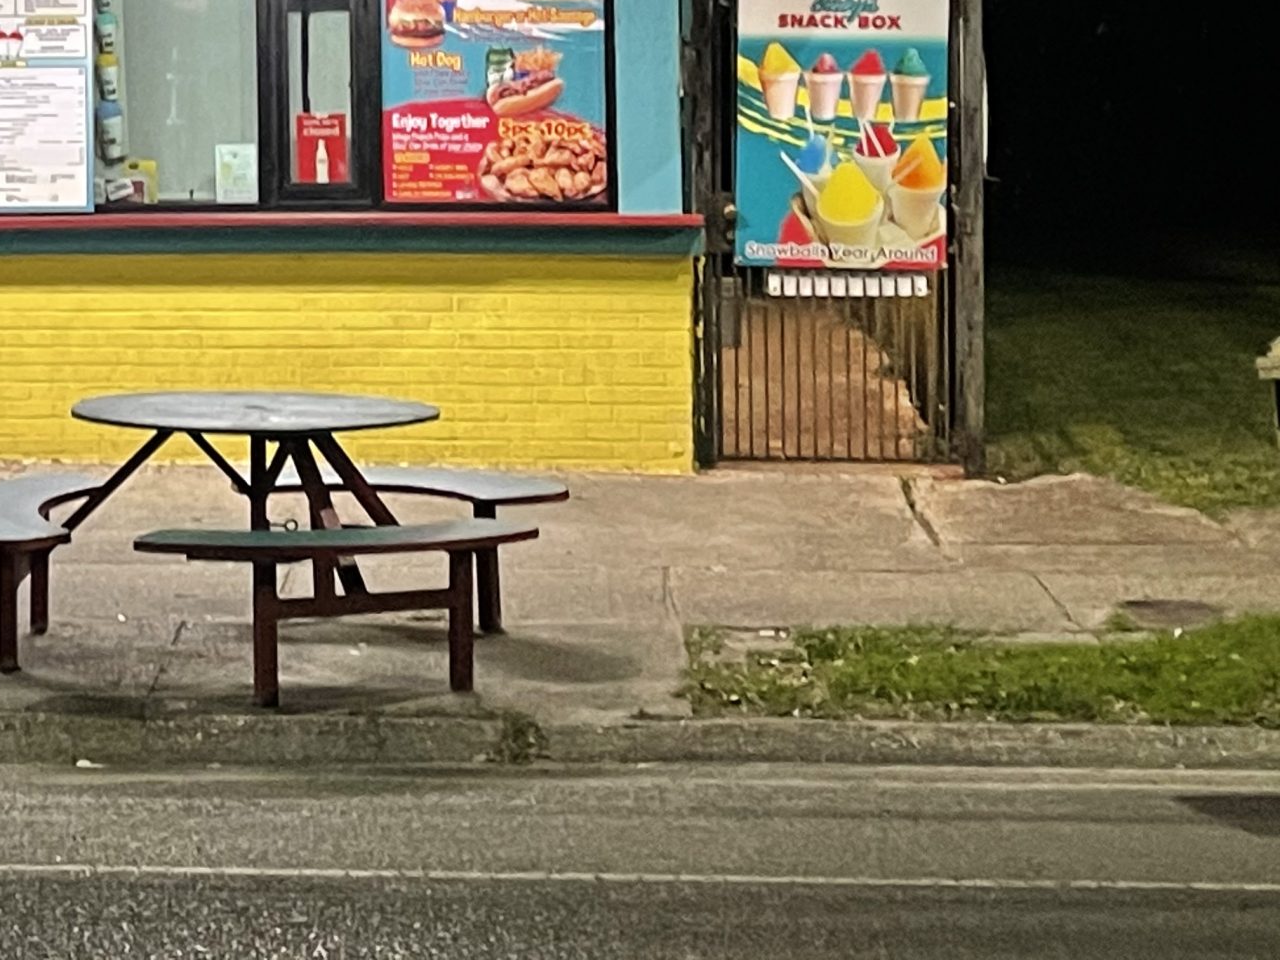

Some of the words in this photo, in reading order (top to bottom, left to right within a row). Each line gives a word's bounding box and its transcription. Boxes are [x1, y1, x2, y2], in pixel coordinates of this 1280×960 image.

[778, 14, 847, 29] SNACK
[858, 14, 902, 30] BOX
[410, 52, 435, 67] Hot
[437, 51, 462, 71] Dog
[392, 113, 428, 132] Enjoy
[430, 113, 490, 132] Together
[745, 242, 827, 259] Snowballs
[832, 243, 869, 260] Year
[875, 245, 938, 261] Around
